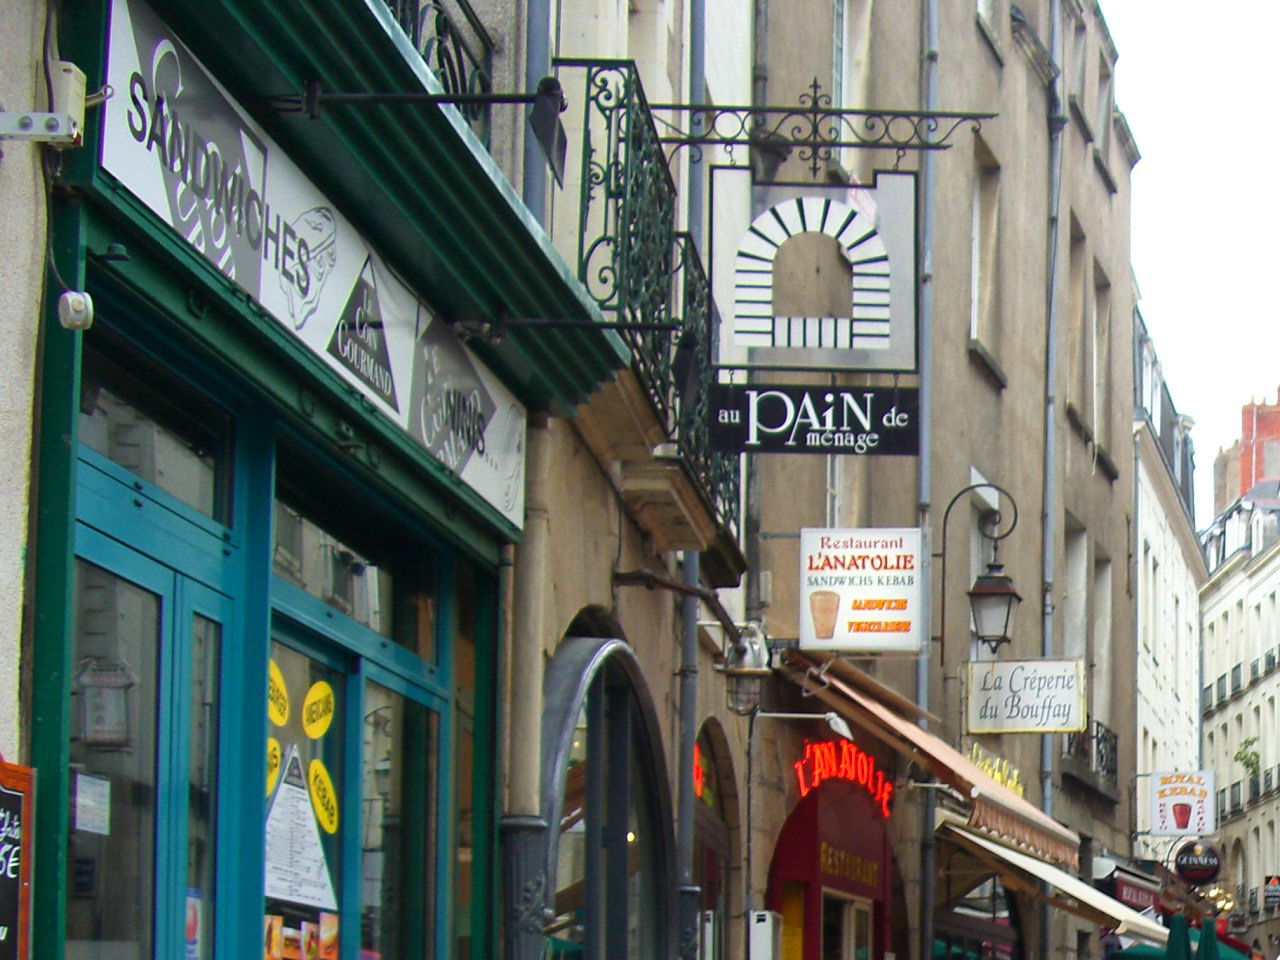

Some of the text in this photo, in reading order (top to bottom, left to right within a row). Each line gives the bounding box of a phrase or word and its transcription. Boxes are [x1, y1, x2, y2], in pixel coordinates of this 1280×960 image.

[337, 319, 392, 397] GOURMAND
[717, 409, 741, 423] au
[882, 406, 909, 427] de
[805, 430, 880, 454] ménage
[820, 535, 904, 550] Restaurant
[807, 551, 916, 571] L'ANATOLIE
[877, 575, 915, 586] KEBAB
[981, 665, 1075, 698] La Crêperie
[980, 694, 1072, 727] du Bouffay
[794, 738, 894, 820] L'ANATOLIE
